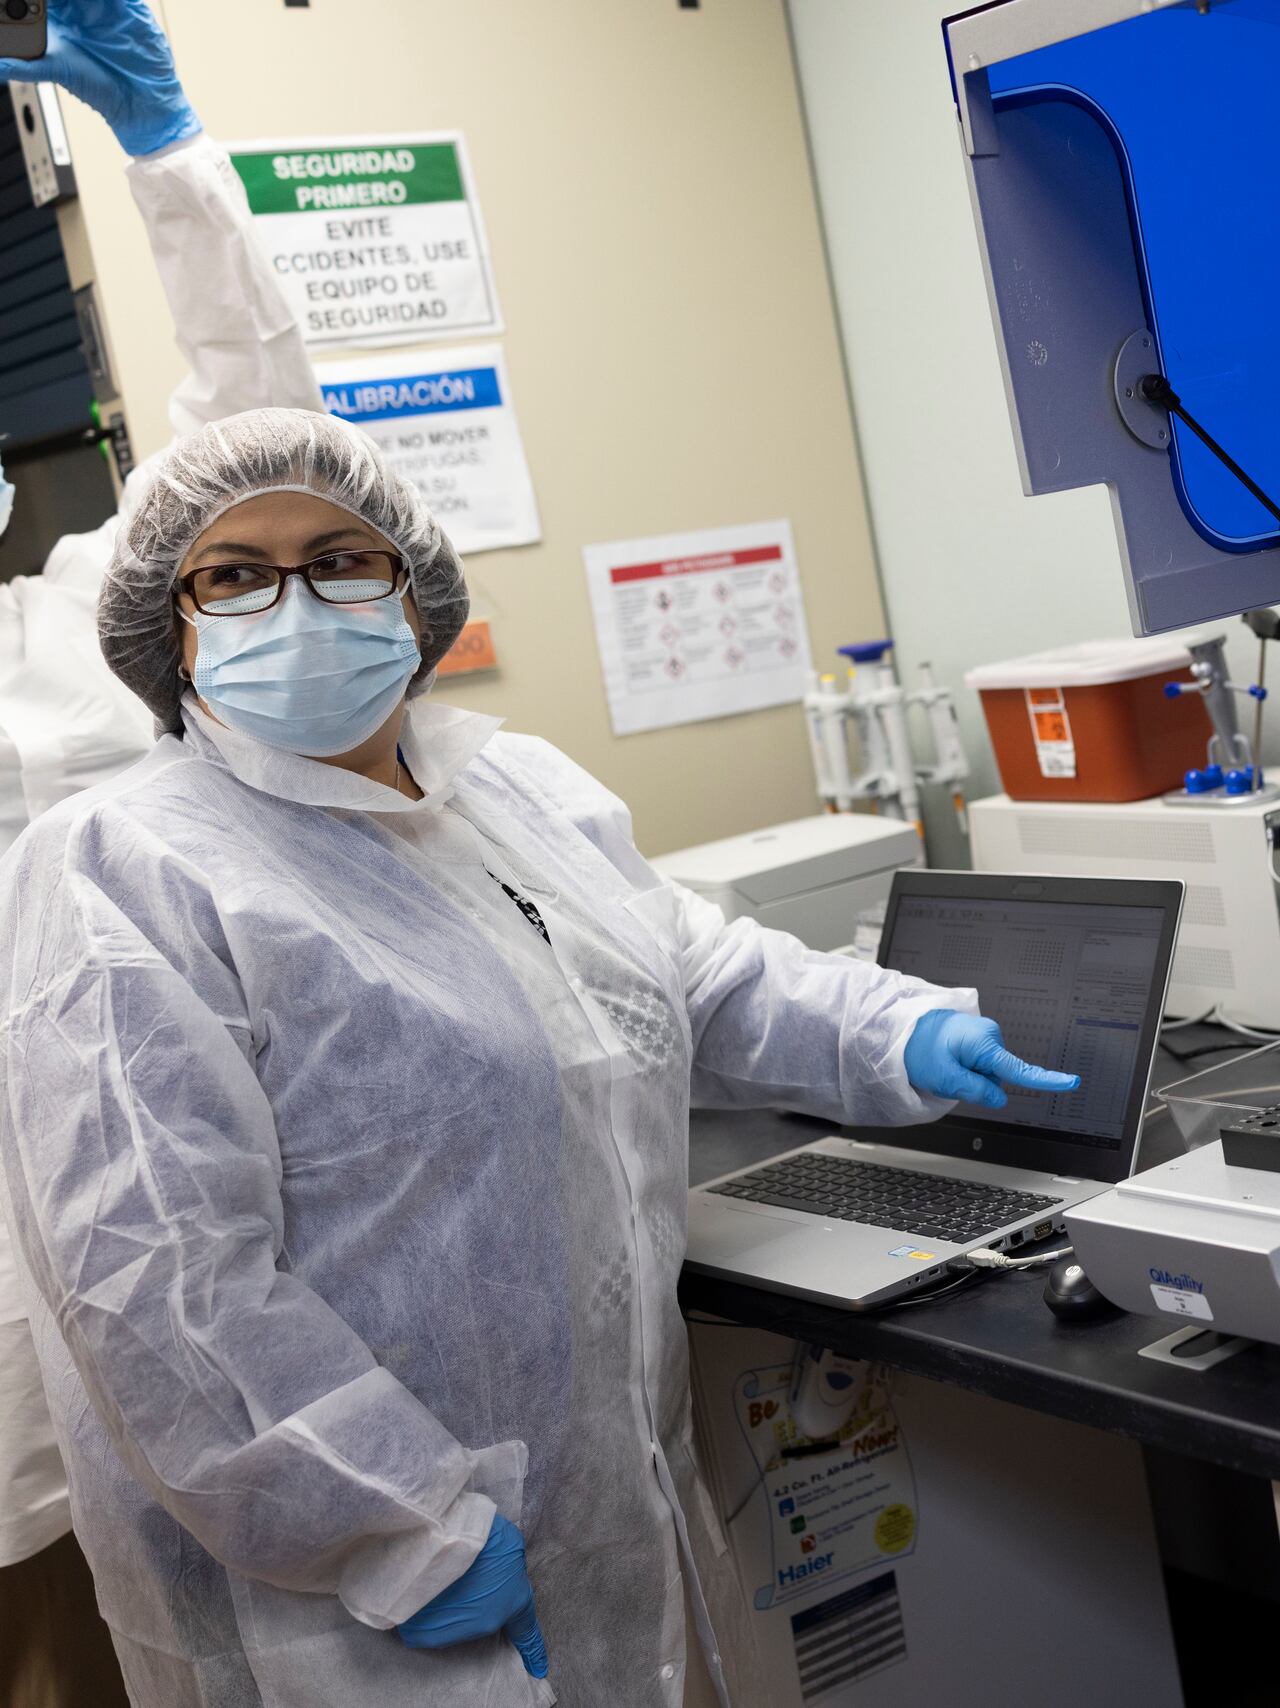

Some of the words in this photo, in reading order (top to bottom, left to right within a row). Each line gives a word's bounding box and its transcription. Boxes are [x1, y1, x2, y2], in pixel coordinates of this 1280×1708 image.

[272, 150, 416, 179] SEGURIDAD
[295, 180, 407, 209] PRIMERO
[325, 216, 393, 241] EVITE
[273, 244, 419, 275] CCIDENTES,
[422, 239, 470, 263] USE
[306, 273, 398, 301] EQUIPO
[405, 270, 437, 292] DE
[307, 298, 448, 332] SEGURIDAD
[325, 374, 476, 416] ALIBRACIÓN
[398, 432, 424, 449] NO
[428, 424, 488, 447] MOVER
[1149, 1268, 1203, 1294] QIAgility
[748, 1399, 779, 1428] Be
[853, 1425, 898, 1456] Now!
[777, 1551, 834, 1585] Haier
